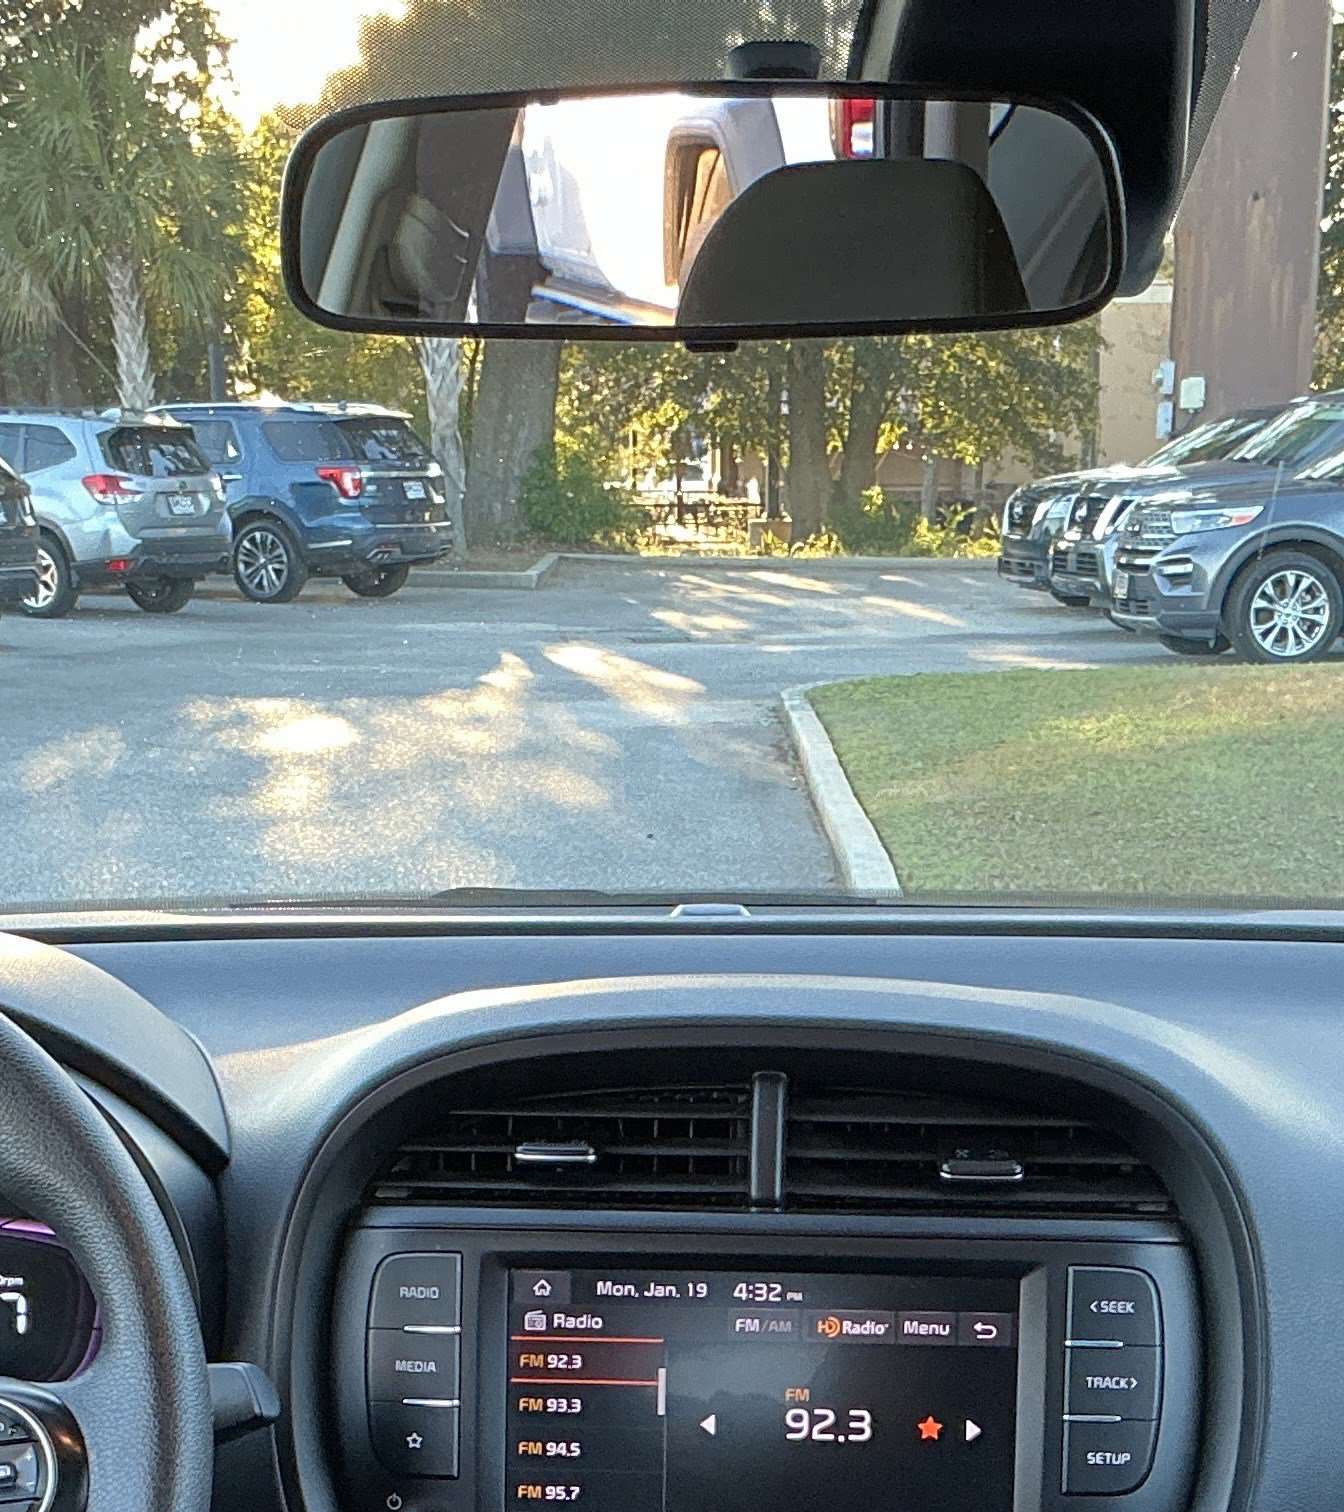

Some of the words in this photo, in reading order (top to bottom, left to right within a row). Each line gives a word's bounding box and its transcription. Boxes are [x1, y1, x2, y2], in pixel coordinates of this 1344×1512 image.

[399, 1286, 440, 1299] RADIO
[687, 1283, 708, 1299] 19
[733, 1282, 782, 1302] 4:32
[553, 1313, 603, 1329] Radio
[735, 1318, 793, 1334] FM/AM
[904, 1319, 951, 1336] Menu
[395, 1359, 437, 1373] MEDIA
[519, 1354, 544, 1368] FM
[546, 1354, 583, 1370] 92.3
[784, 1388, 810, 1402] FM
[518, 1398, 544, 1412] FM
[546, 1398, 582, 1414] 93.3
[784, 1408, 873, 1443] 92.3
[517, 1442, 543, 1456] FM
[545, 1442, 582, 1458] 94.5
[1086, 1452, 1131, 1465] SETUP
[517, 1485, 542, 1499] FM
[544, 1486, 581, 1502] 95.7
